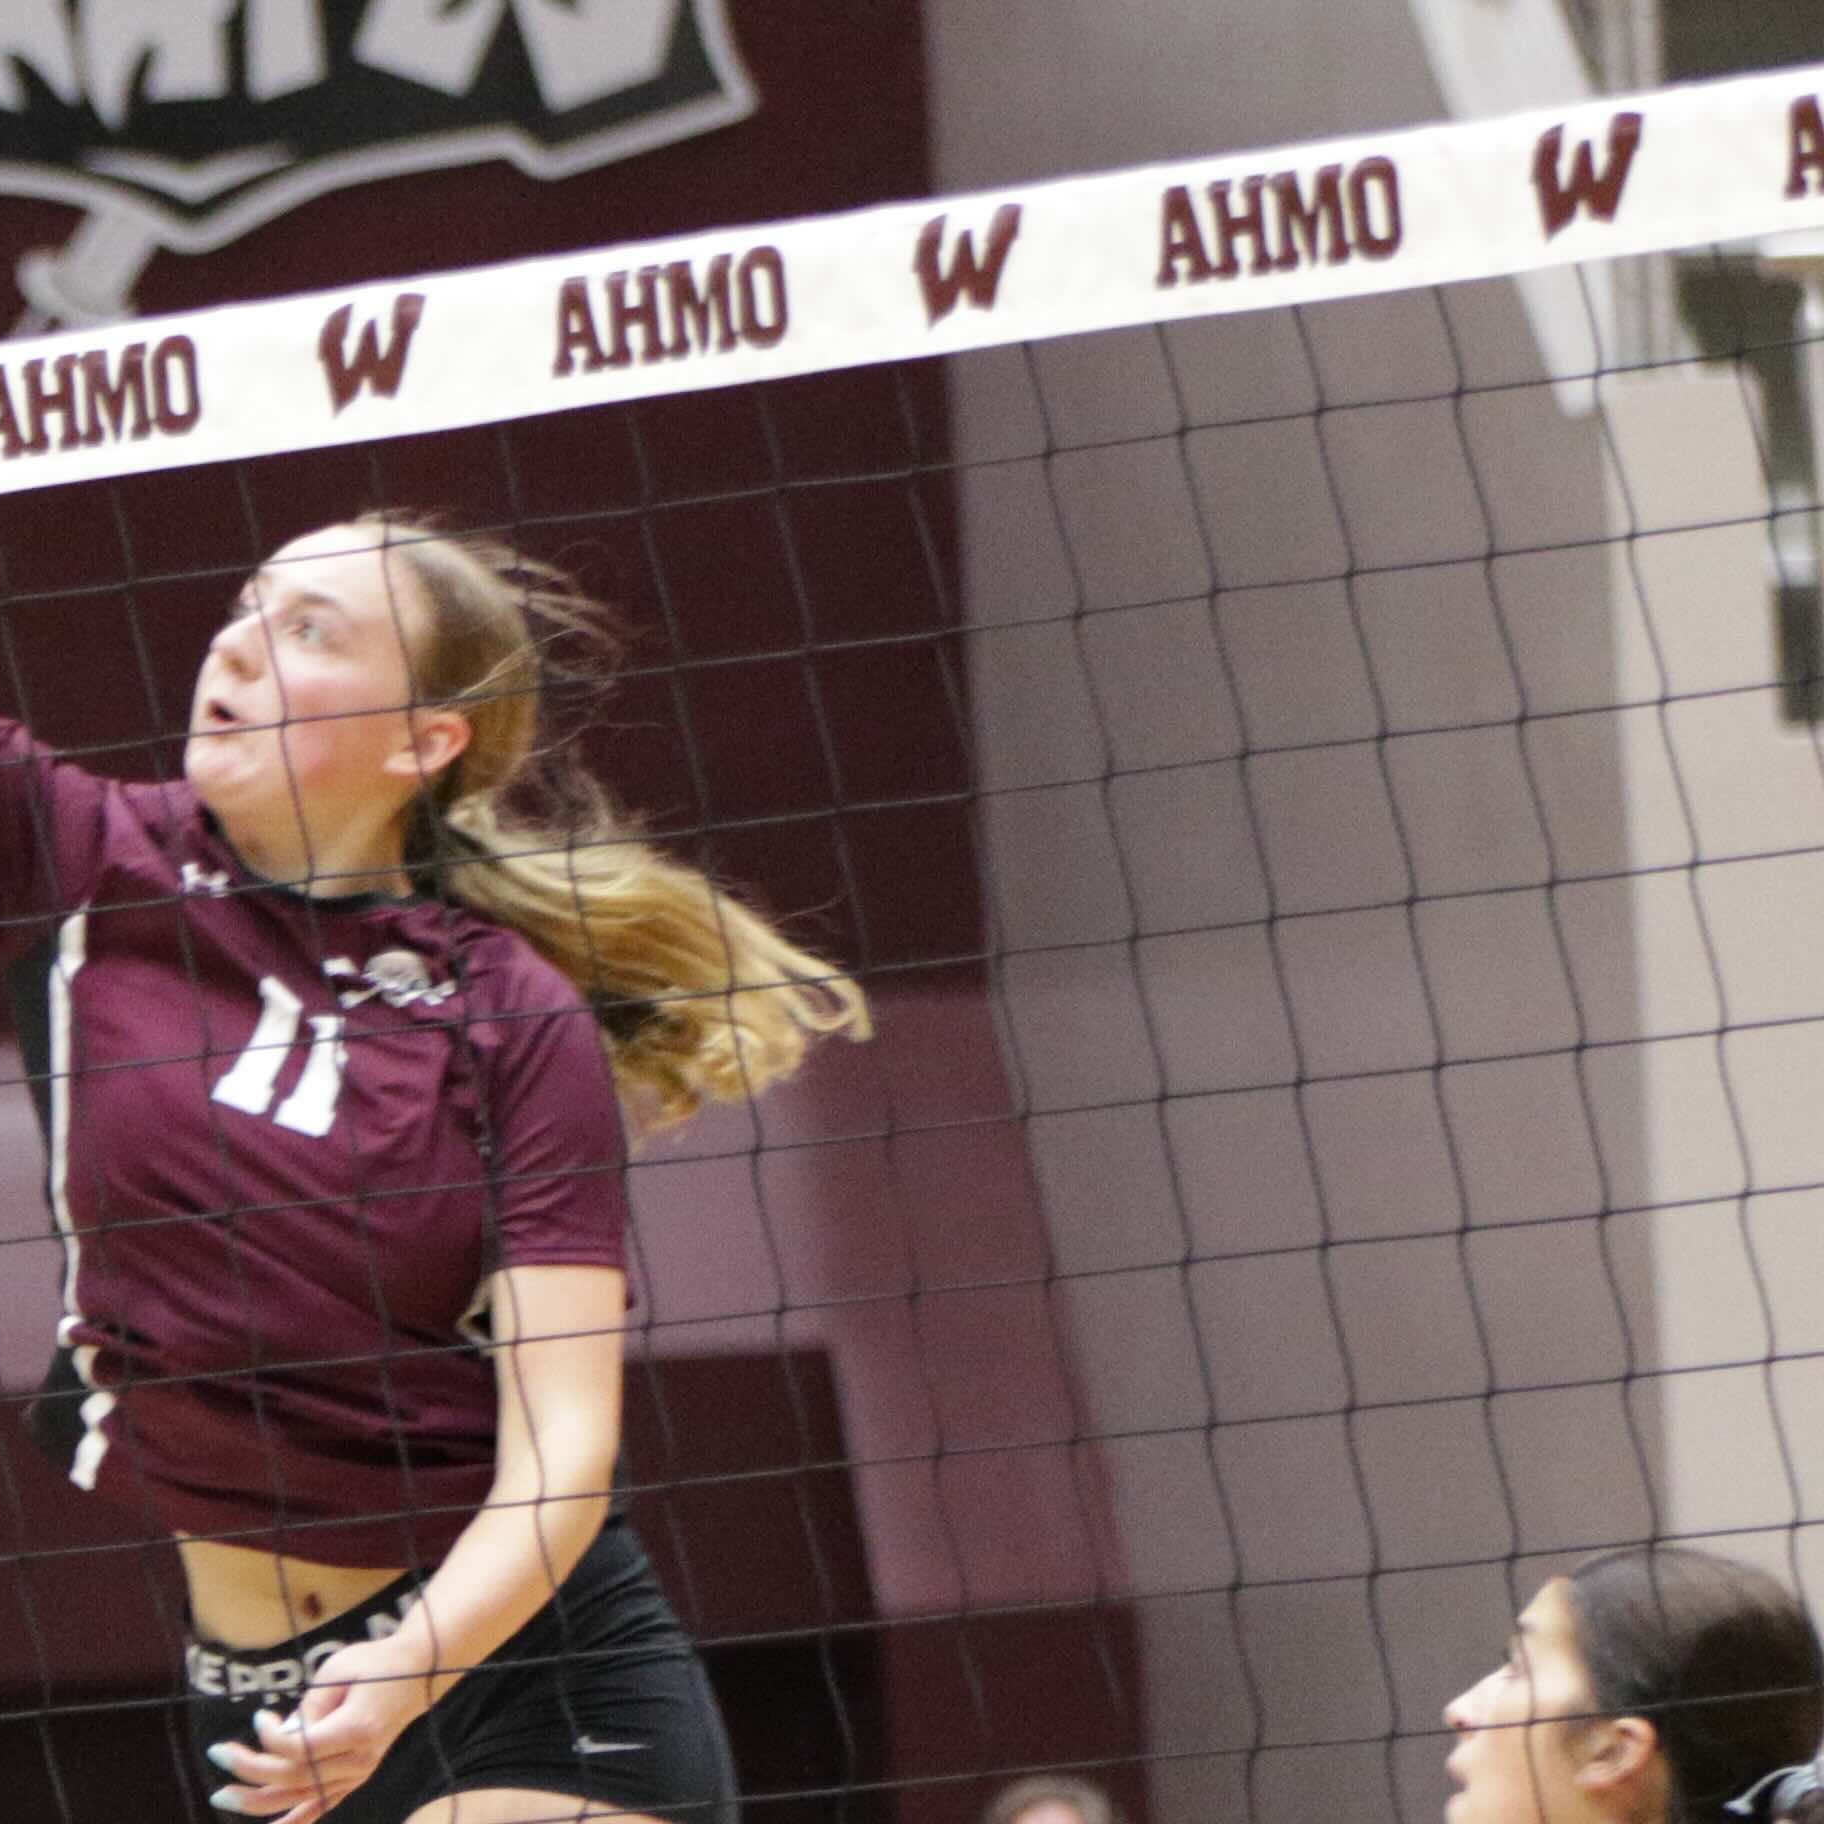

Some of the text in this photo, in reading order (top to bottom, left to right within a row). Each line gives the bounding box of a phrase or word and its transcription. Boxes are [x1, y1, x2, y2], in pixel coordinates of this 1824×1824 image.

[317, 292, 425, 412] W
[552, 244, 790, 377] AHMO
[912, 205, 1022, 323] W
[1155, 154, 1405, 289] AHMO
[1530, 110, 1644, 237] W
[209, 975, 349, 1137] 11
